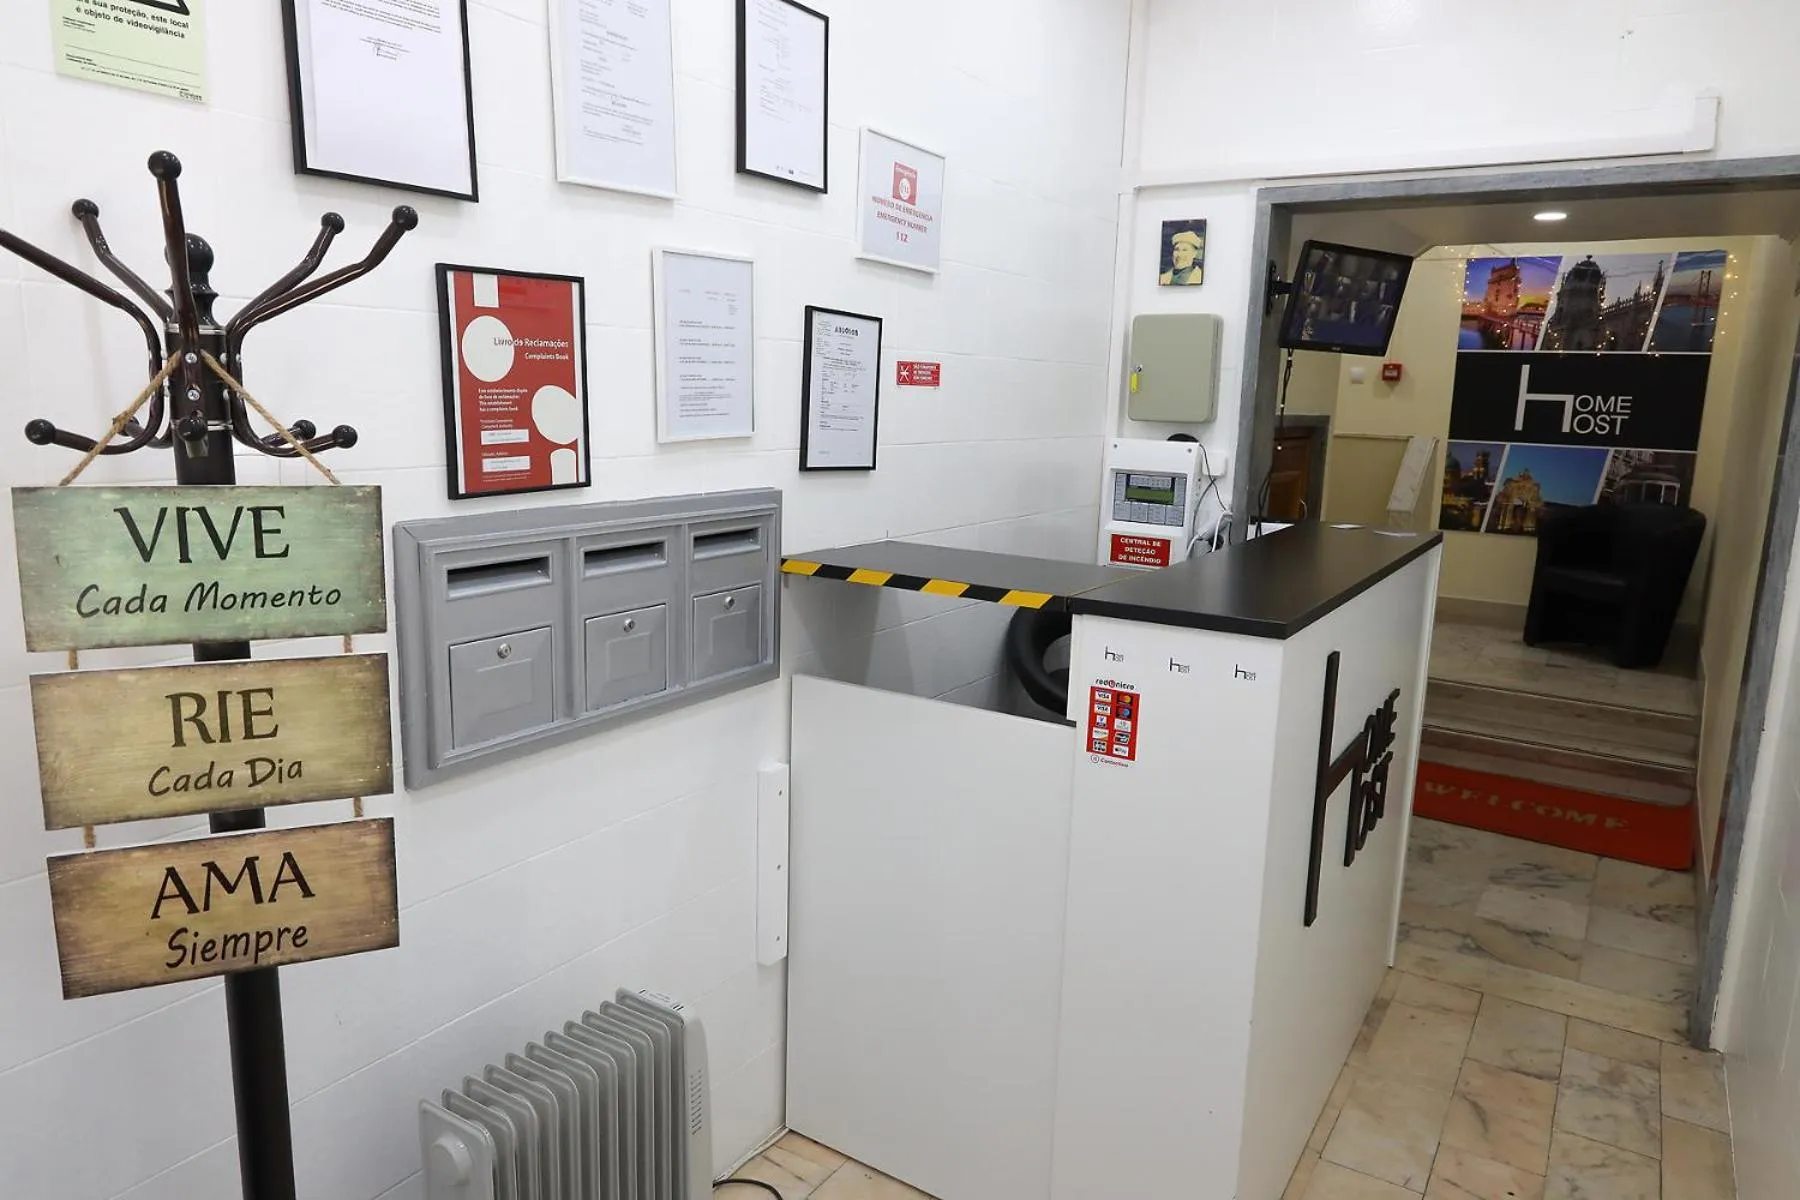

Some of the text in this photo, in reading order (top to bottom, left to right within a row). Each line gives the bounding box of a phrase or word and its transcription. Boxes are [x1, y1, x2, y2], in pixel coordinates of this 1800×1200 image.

[84, 8, 111, 20] objeto
[113, 15, 124, 24] de
[151, 14, 167, 24] este
[170, 19, 189, 29] local
[493, 337, 569, 349] Livro de Reclamações
[525, 352, 569, 361] Complaints Book
[113, 505, 290, 564] VIVE
[1120, 537, 1151, 547] CENTRAL
[76, 581, 342, 618] Cada Momento
[165, 687, 279, 748] RIE
[148, 757, 303, 797] Cada Dia
[1424, 781, 1631, 832] WELCOME
[150, 851, 316, 920] AMA
[166, 925, 308, 969] Siempre
